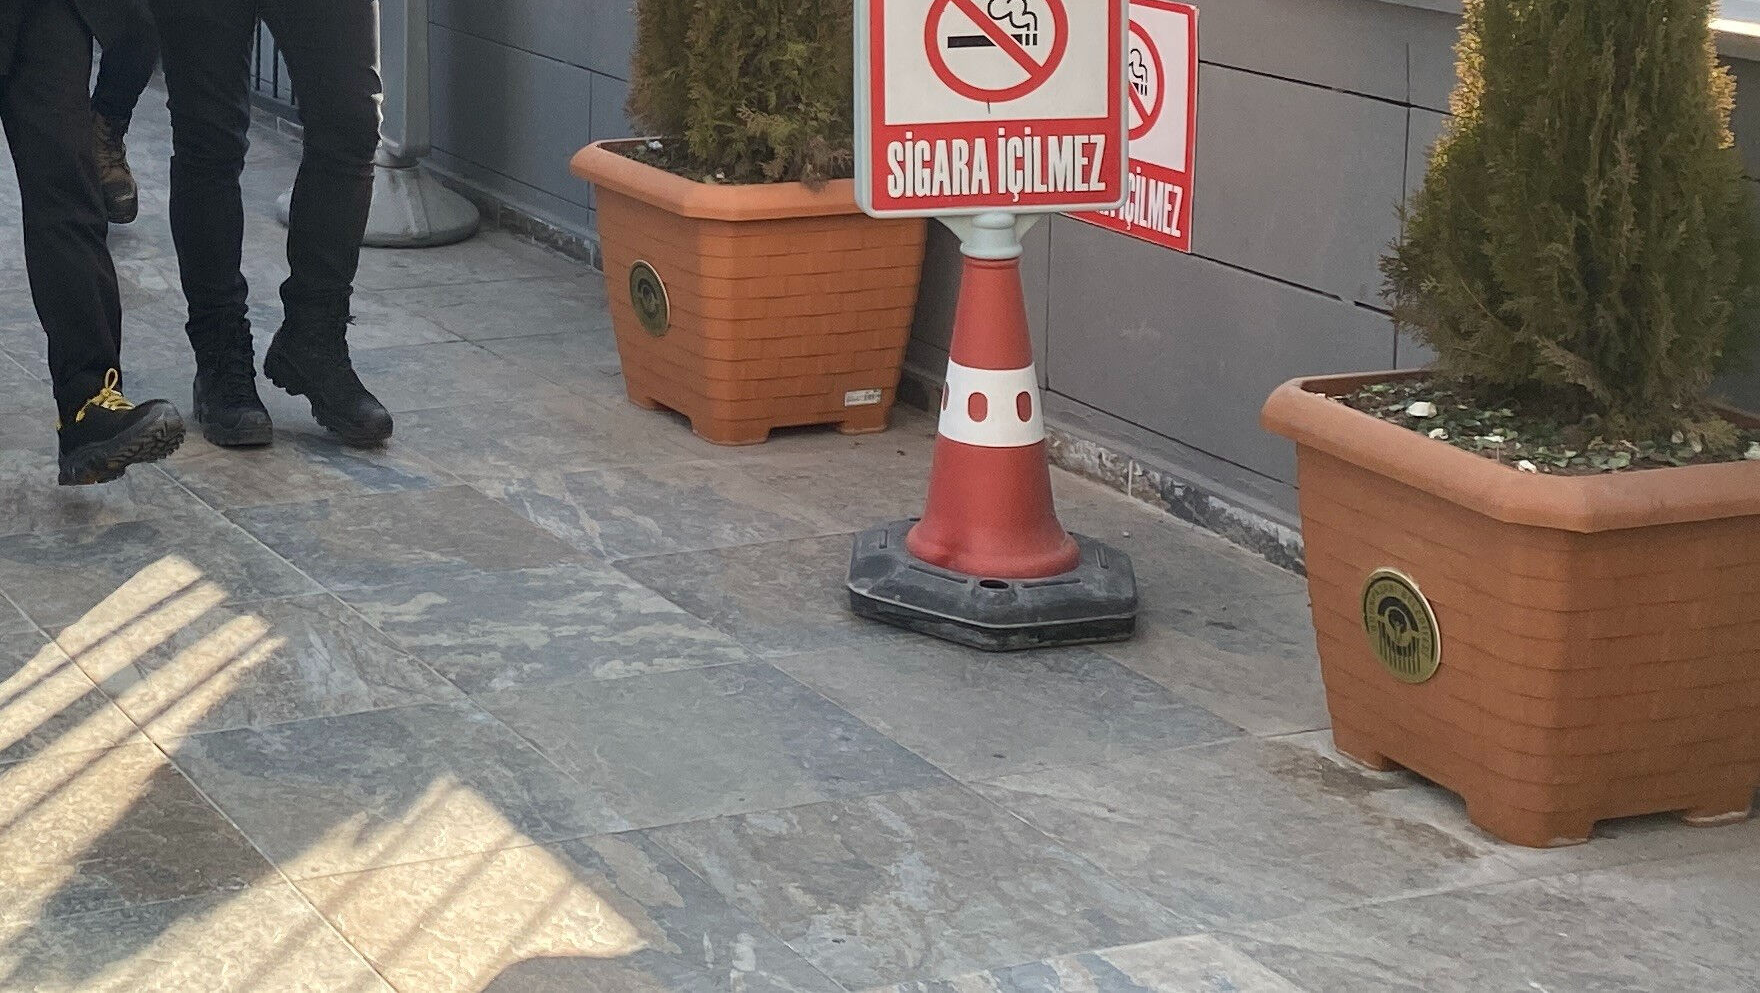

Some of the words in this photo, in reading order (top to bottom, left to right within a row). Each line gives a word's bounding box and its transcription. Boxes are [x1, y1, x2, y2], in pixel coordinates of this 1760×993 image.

[887, 132, 990, 198] SİGARA
[997, 127, 1106, 202] İÇİLMEZ
[1119, 167, 1183, 238] ÇİLMEZ
